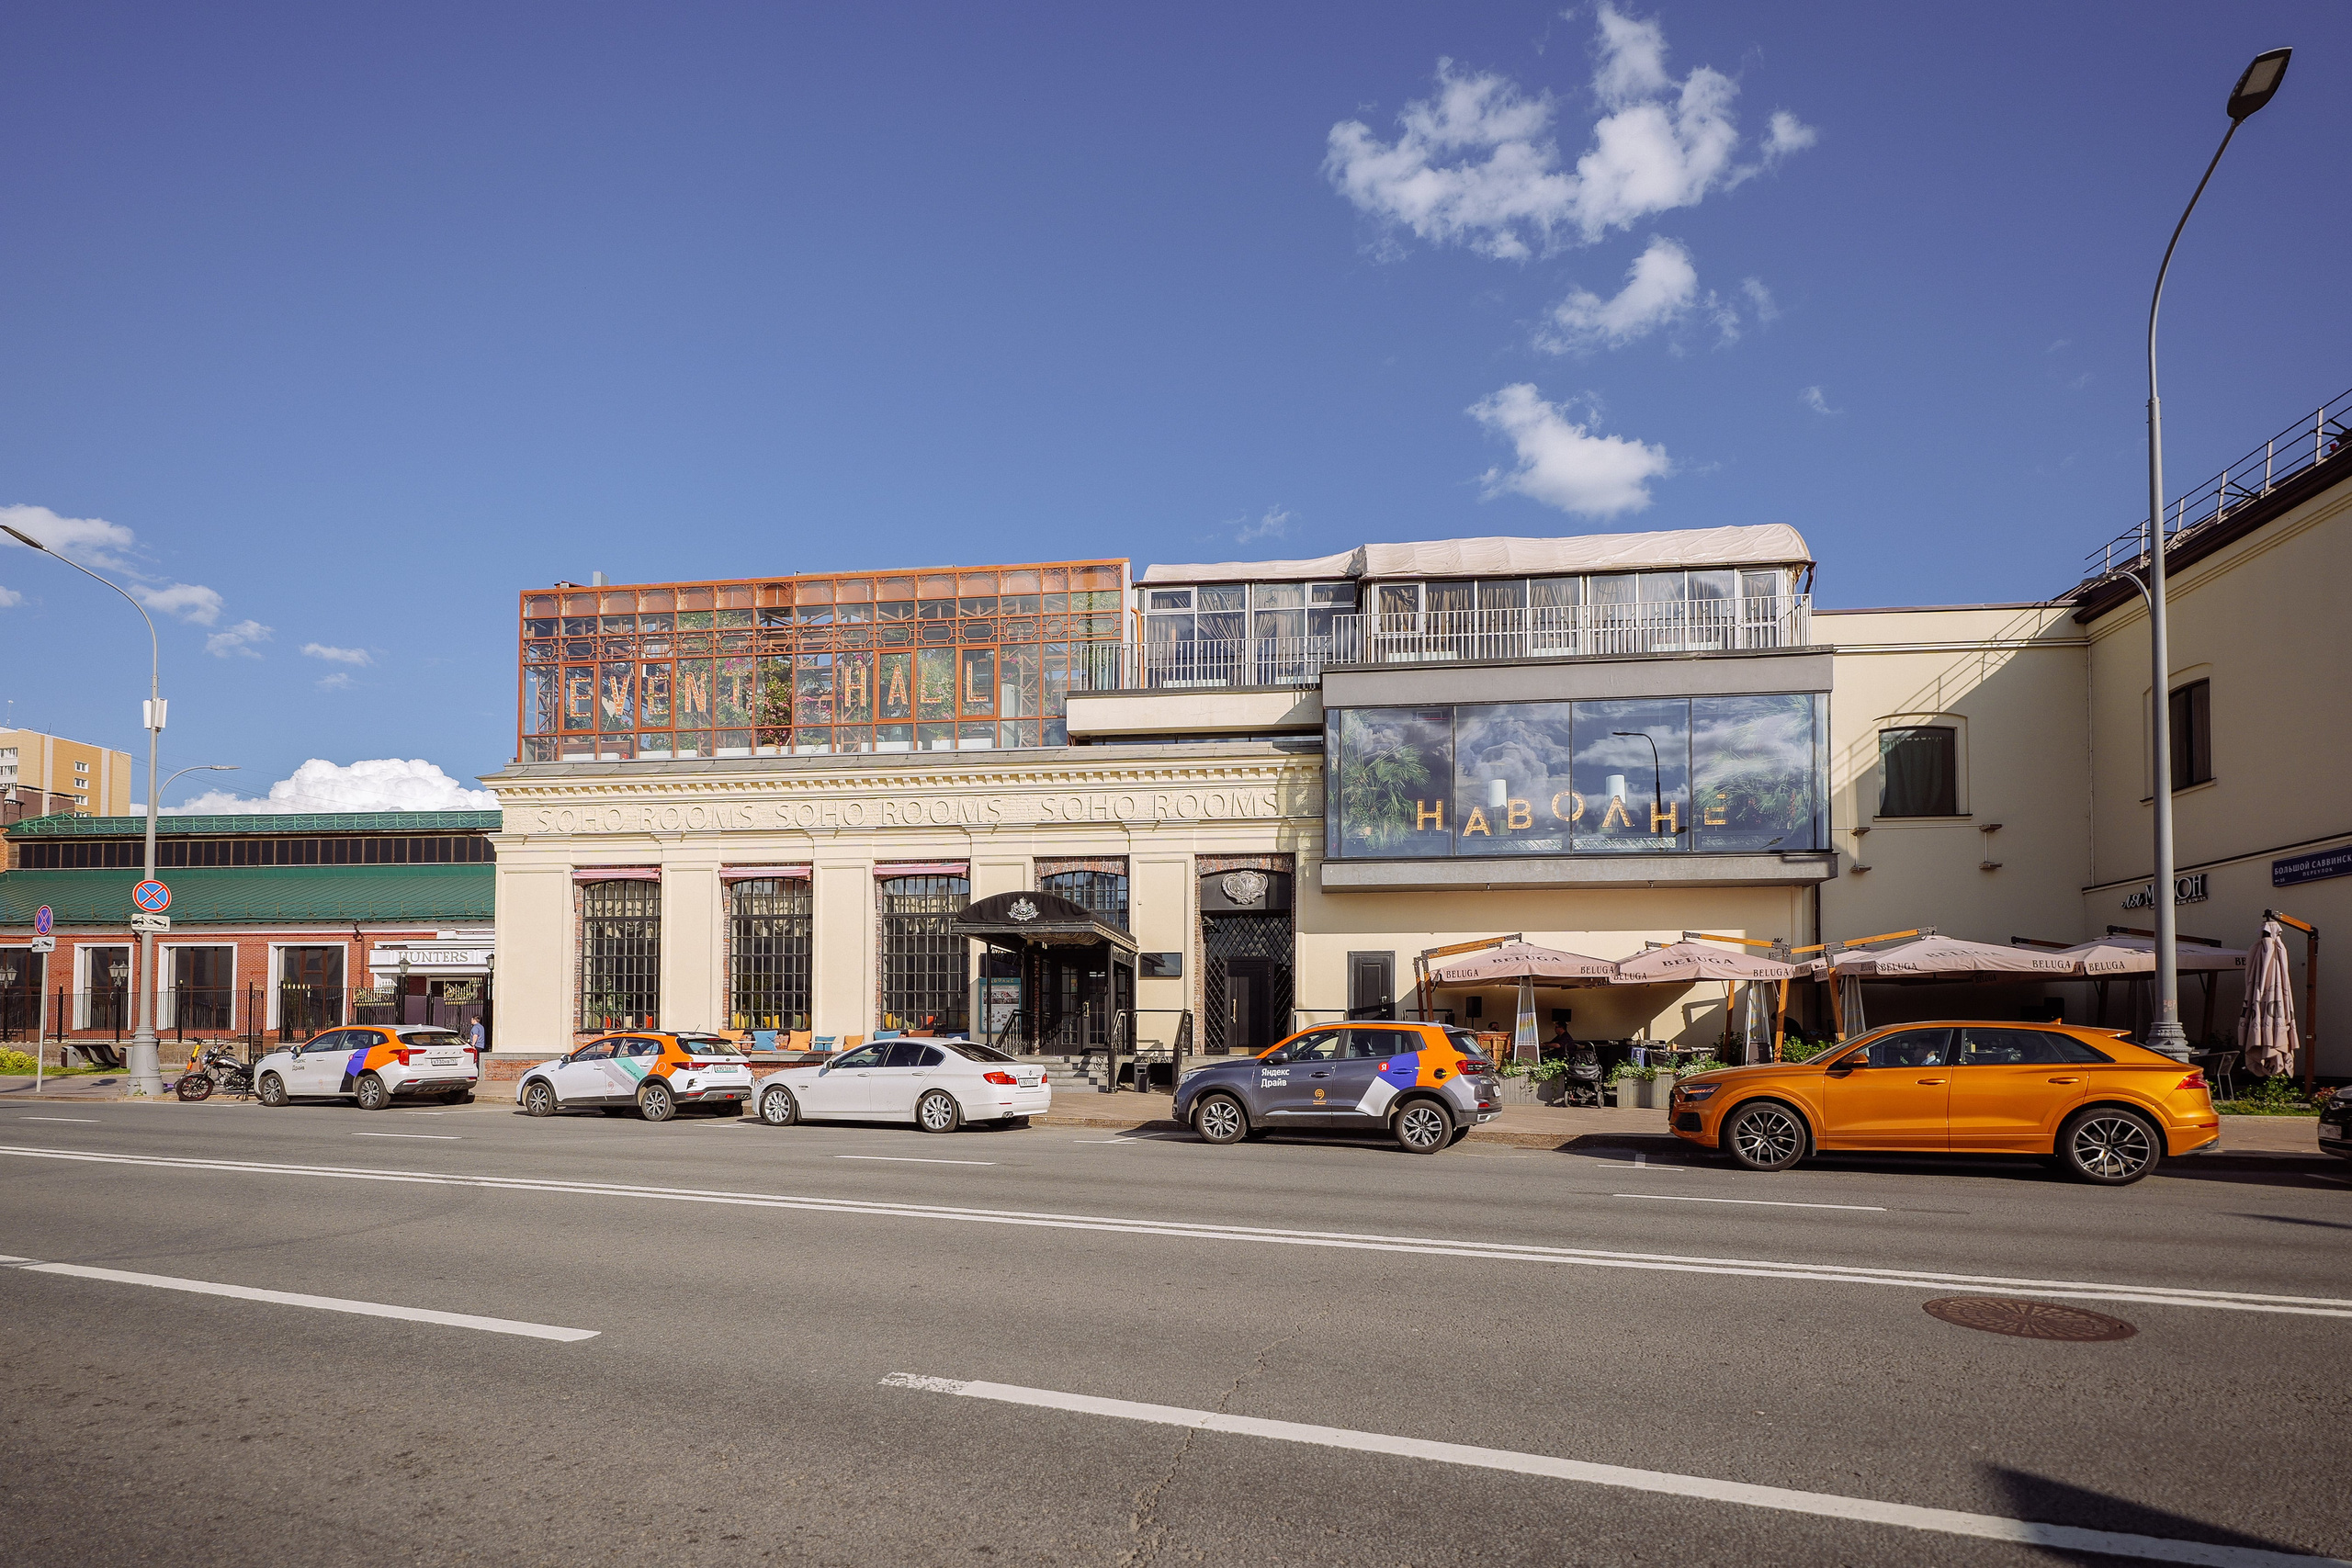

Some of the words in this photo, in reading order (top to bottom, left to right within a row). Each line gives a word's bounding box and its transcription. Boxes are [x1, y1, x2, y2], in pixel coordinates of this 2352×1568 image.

[570, 671, 747, 717] EVENT
[844, 660, 989, 707] HALL
[537, 808, 625, 832] SOHO
[639, 806, 755, 830] ROOMS
[775, 801, 866, 828] SOHO
[880, 798, 1003, 825] ROOMS
[1040, 795, 1138, 821] SOHO
[1152, 790, 1279, 818] ROOMS
[2274, 861, 2310, 875] БОЛЬШОЙ
[2302, 867, 2333, 876] ПЕРЕУЛОК
[2144, 874, 2202, 906] МОН
[398, 951, 469, 963] HUNTERS
[1662, 956, 1735, 966] BELUGA
[1880, 962, 1917, 971] BELUGA
[2032, 959, 2071, 969] BELUGA
[2088, 961, 2125, 972] BELUGA
[1446, 969, 1479, 978] BELUGA
[1580, 965, 1614, 975] BELUGA
[1753, 967, 1789, 976] BELUGA
[1613, 972, 1647, 980] BELUGA
[1261, 1067, 1290, 1077] Яндекс
[1261, 1078, 1287, 1089] Драйв
